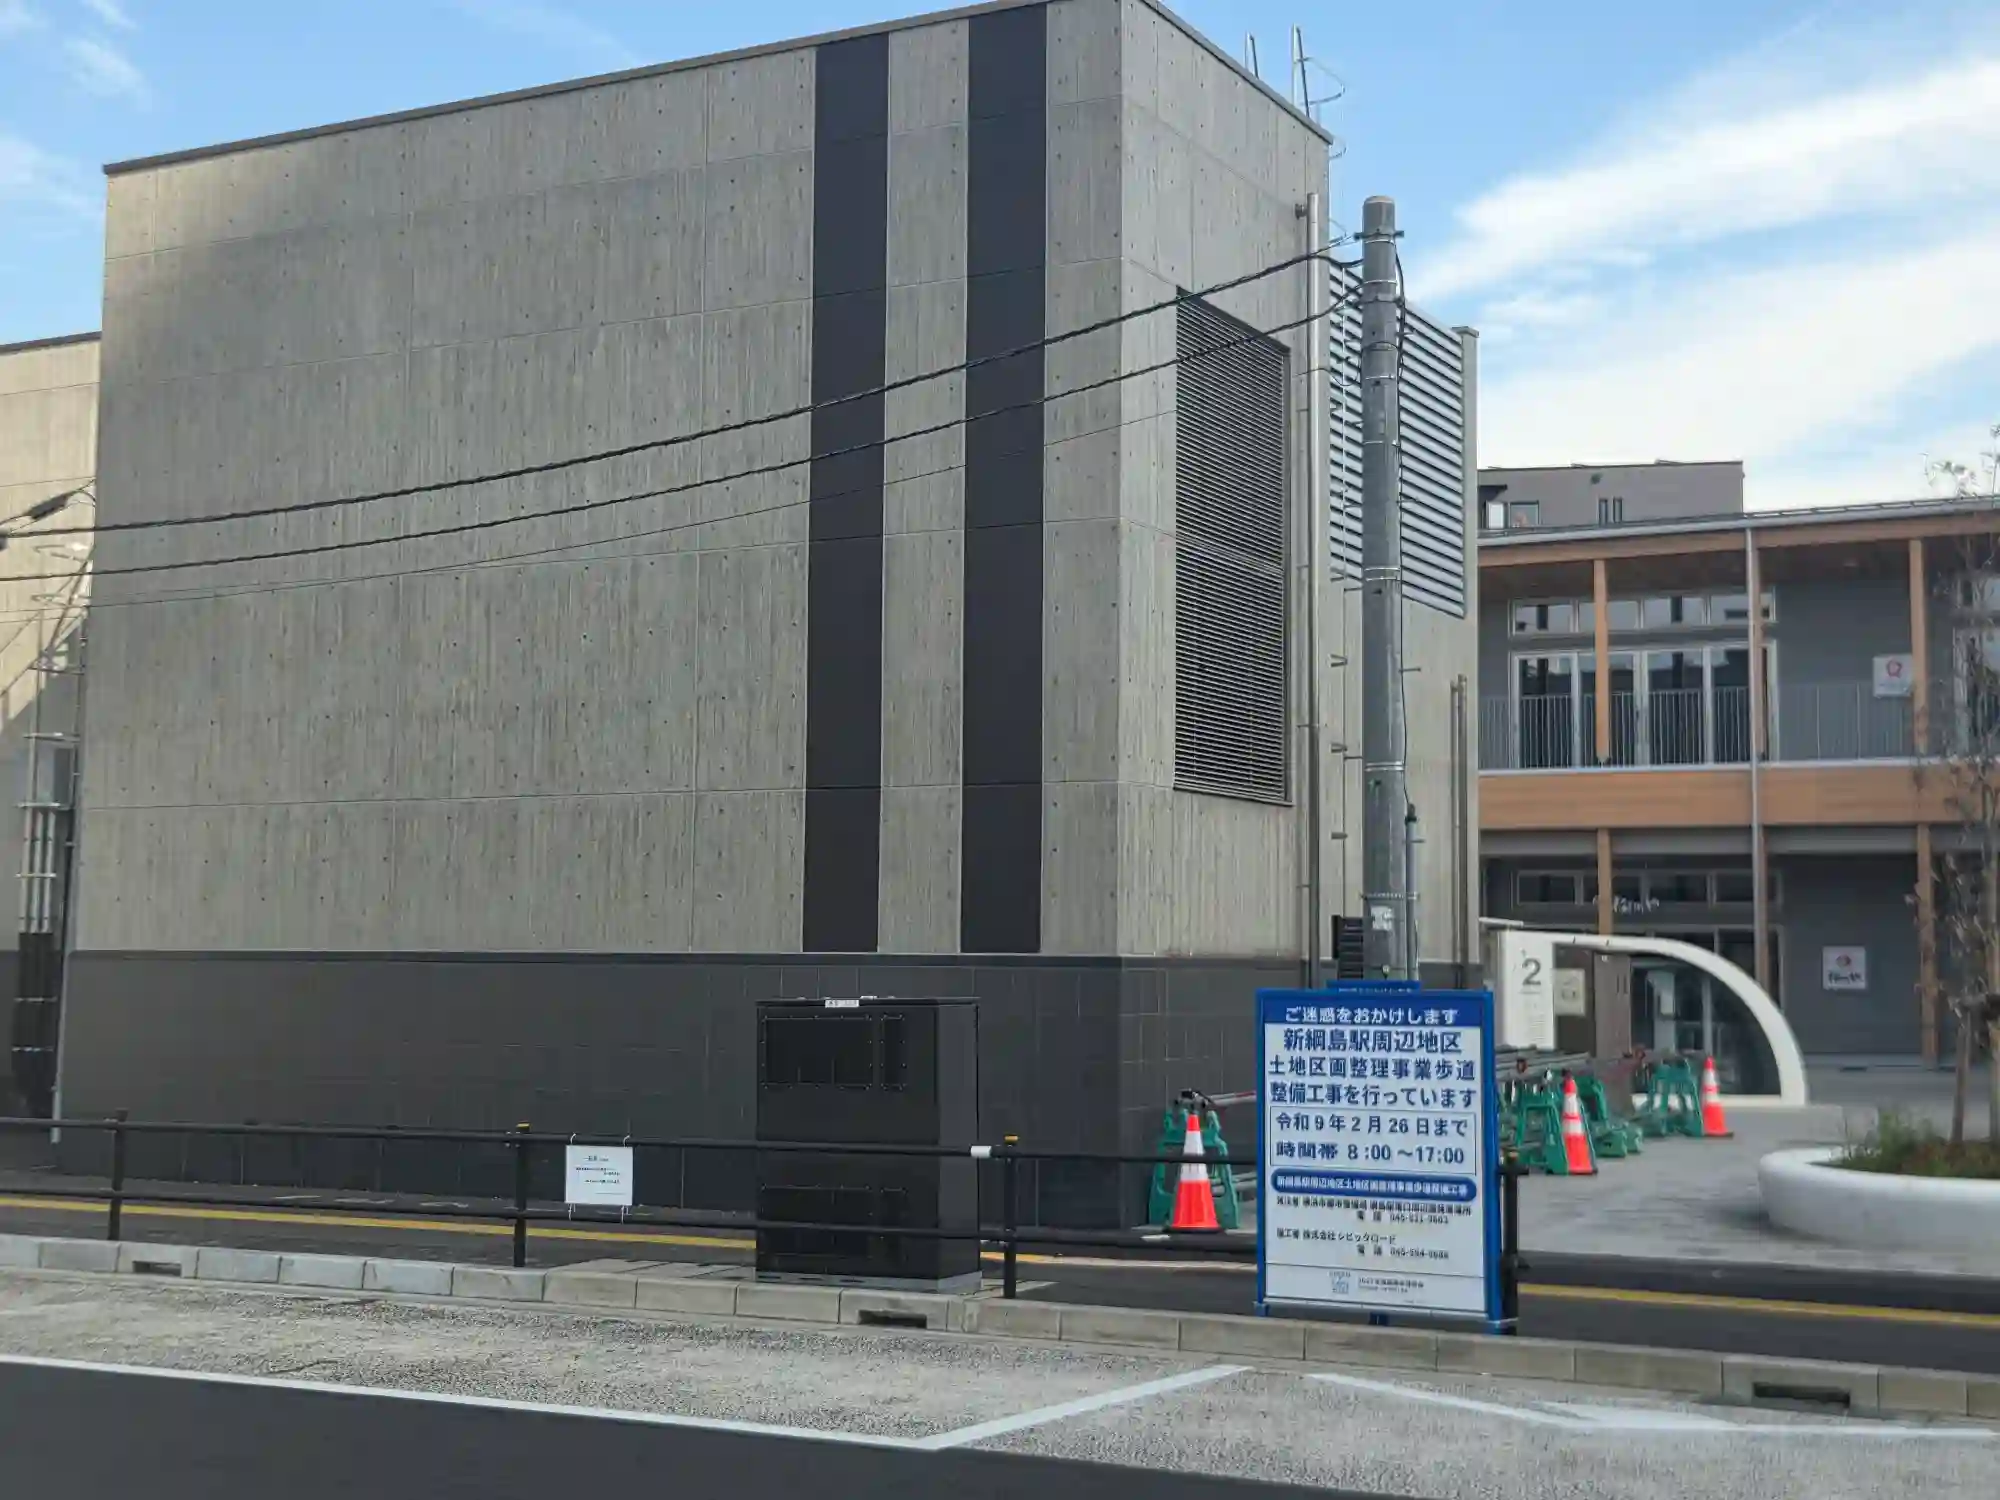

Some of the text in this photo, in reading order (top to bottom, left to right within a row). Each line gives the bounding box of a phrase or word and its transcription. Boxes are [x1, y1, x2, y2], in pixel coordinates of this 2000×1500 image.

[1522, 957, 1542, 986] 2
[1286, 1006, 1459, 1025] ご迷惑をおかけします
[1283, 1028, 1462, 1054] 新綱島駅周辺地区
[1268, 1055, 1475, 1081] 土地区画整理事業歩道
[1270, 1081, 1476, 1108] 整備工事を行っています
[1276, 1141, 1338, 1160] 時間帯
